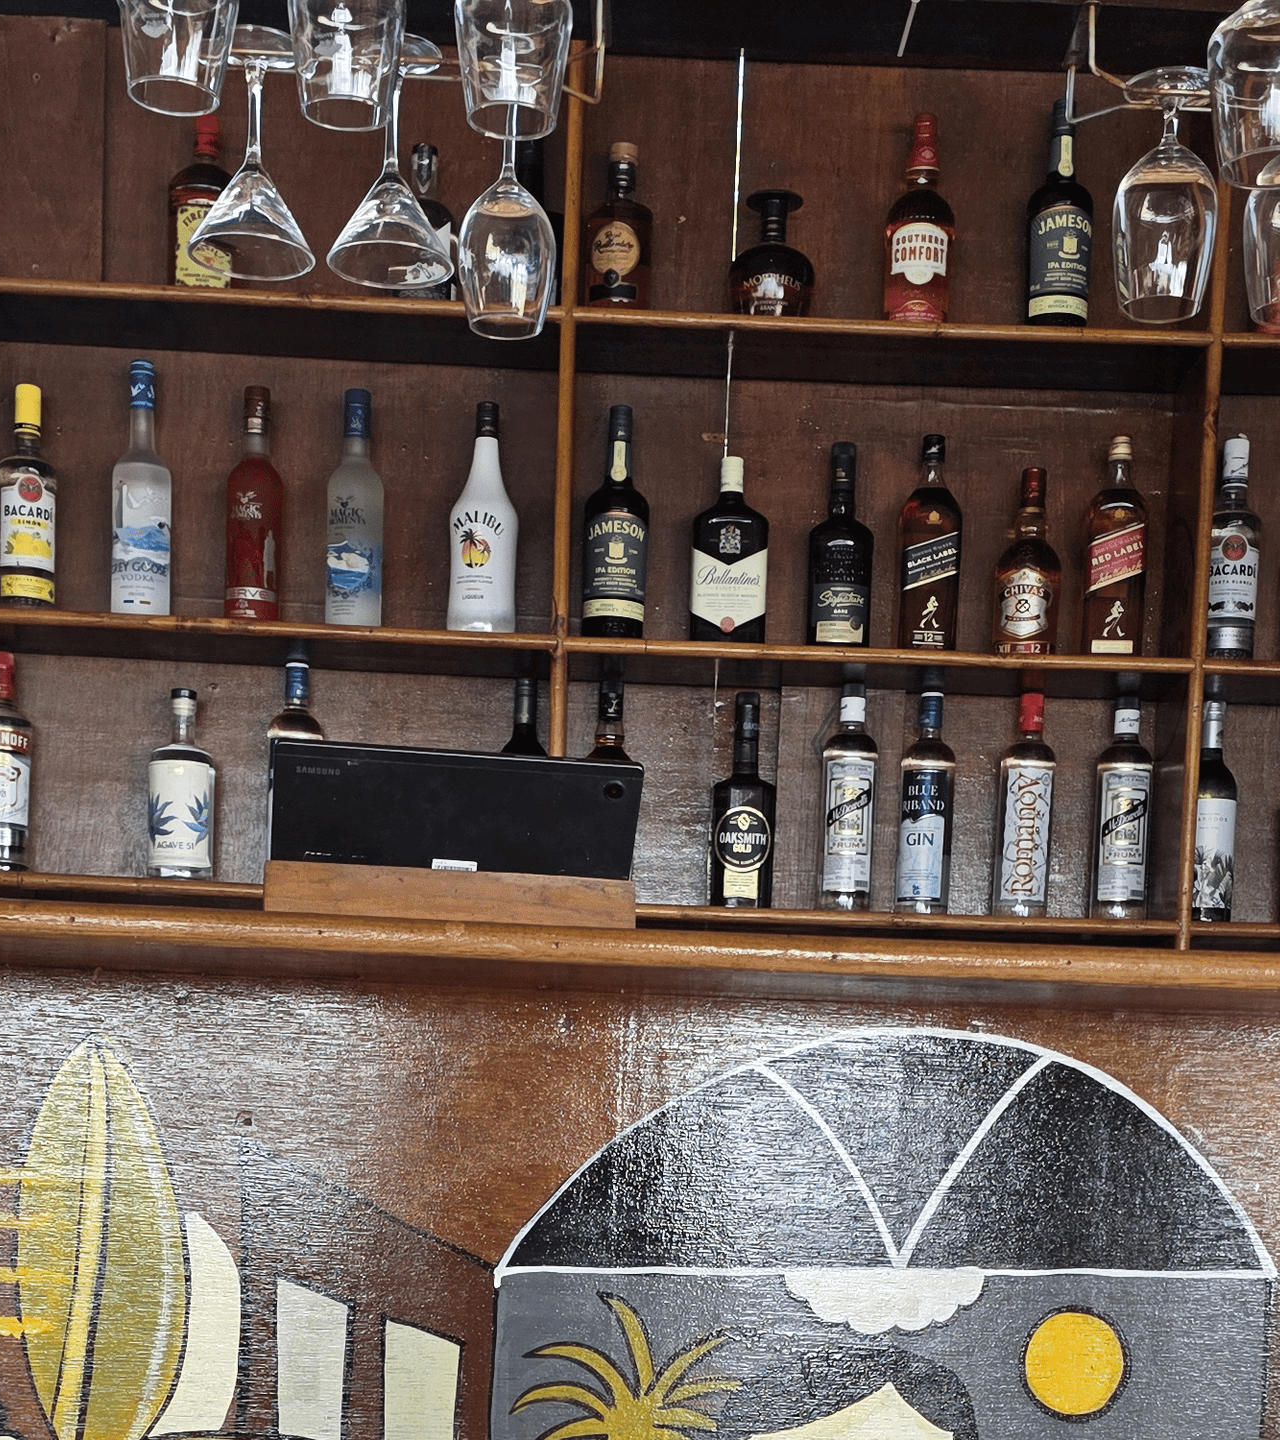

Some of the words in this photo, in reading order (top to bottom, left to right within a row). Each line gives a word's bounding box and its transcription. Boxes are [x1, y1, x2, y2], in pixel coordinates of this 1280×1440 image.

[1038, 214, 1091, 239] JAMESON
[896, 234, 944, 246] SOUTHERN
[894, 246, 944, 264] COMFORT
[1061, 262, 1086, 272] EDITION
[331, 507, 363, 518] MAGIC
[453, 510, 505, 536] MALIBU
[588, 520, 645, 542] JAMESON
[907, 555, 932, 568] BLACK
[933, 547, 958, 560] LABEL
[1091, 552, 1112, 566] RED
[1114, 541, 1144, 558] LABEL
[607, 566, 636, 575] EDITION
[696, 564, 761, 587] Ballantine's
[120, 574, 155, 582] VODKA
[817, 589, 865, 607] Signature
[1004, 585, 1045, 598] CHIVAS
[923, 632, 934, 642] 12
[1030, 643, 1041, 653] 12
[296, 766, 341, 776] SAMSUNG
[908, 785, 938, 796] BLUE
[903, 799, 945, 812] RIBAND
[720, 832, 767, 845] OAKSMITH
[906, 832, 935, 847] GIN
[156, 841, 183, 850] AGAVE
[733, 844, 752, 853] GOLD
